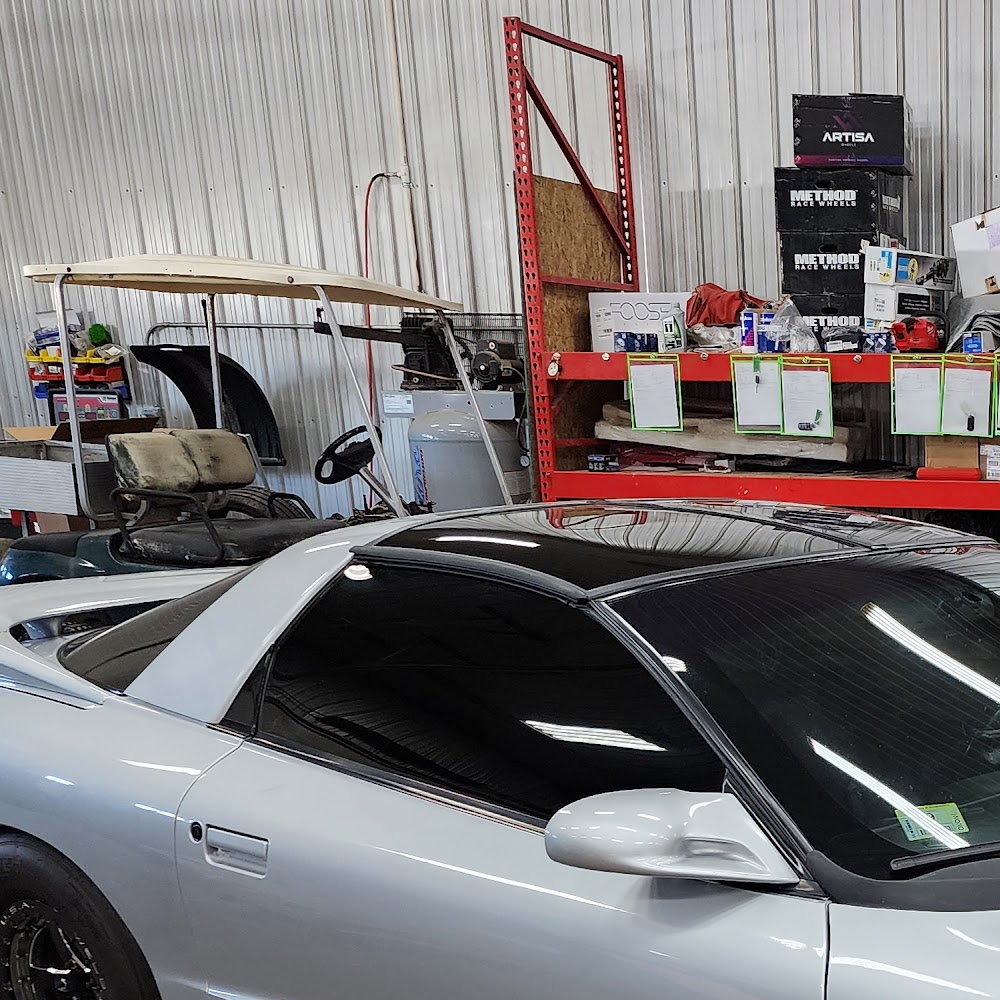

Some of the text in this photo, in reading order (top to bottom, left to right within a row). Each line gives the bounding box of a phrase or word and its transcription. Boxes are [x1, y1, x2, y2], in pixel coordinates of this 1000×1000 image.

[822, 132, 875, 142] ARTISA
[790, 190, 857, 201] METHOD
[794, 254, 860, 264] METHOD
